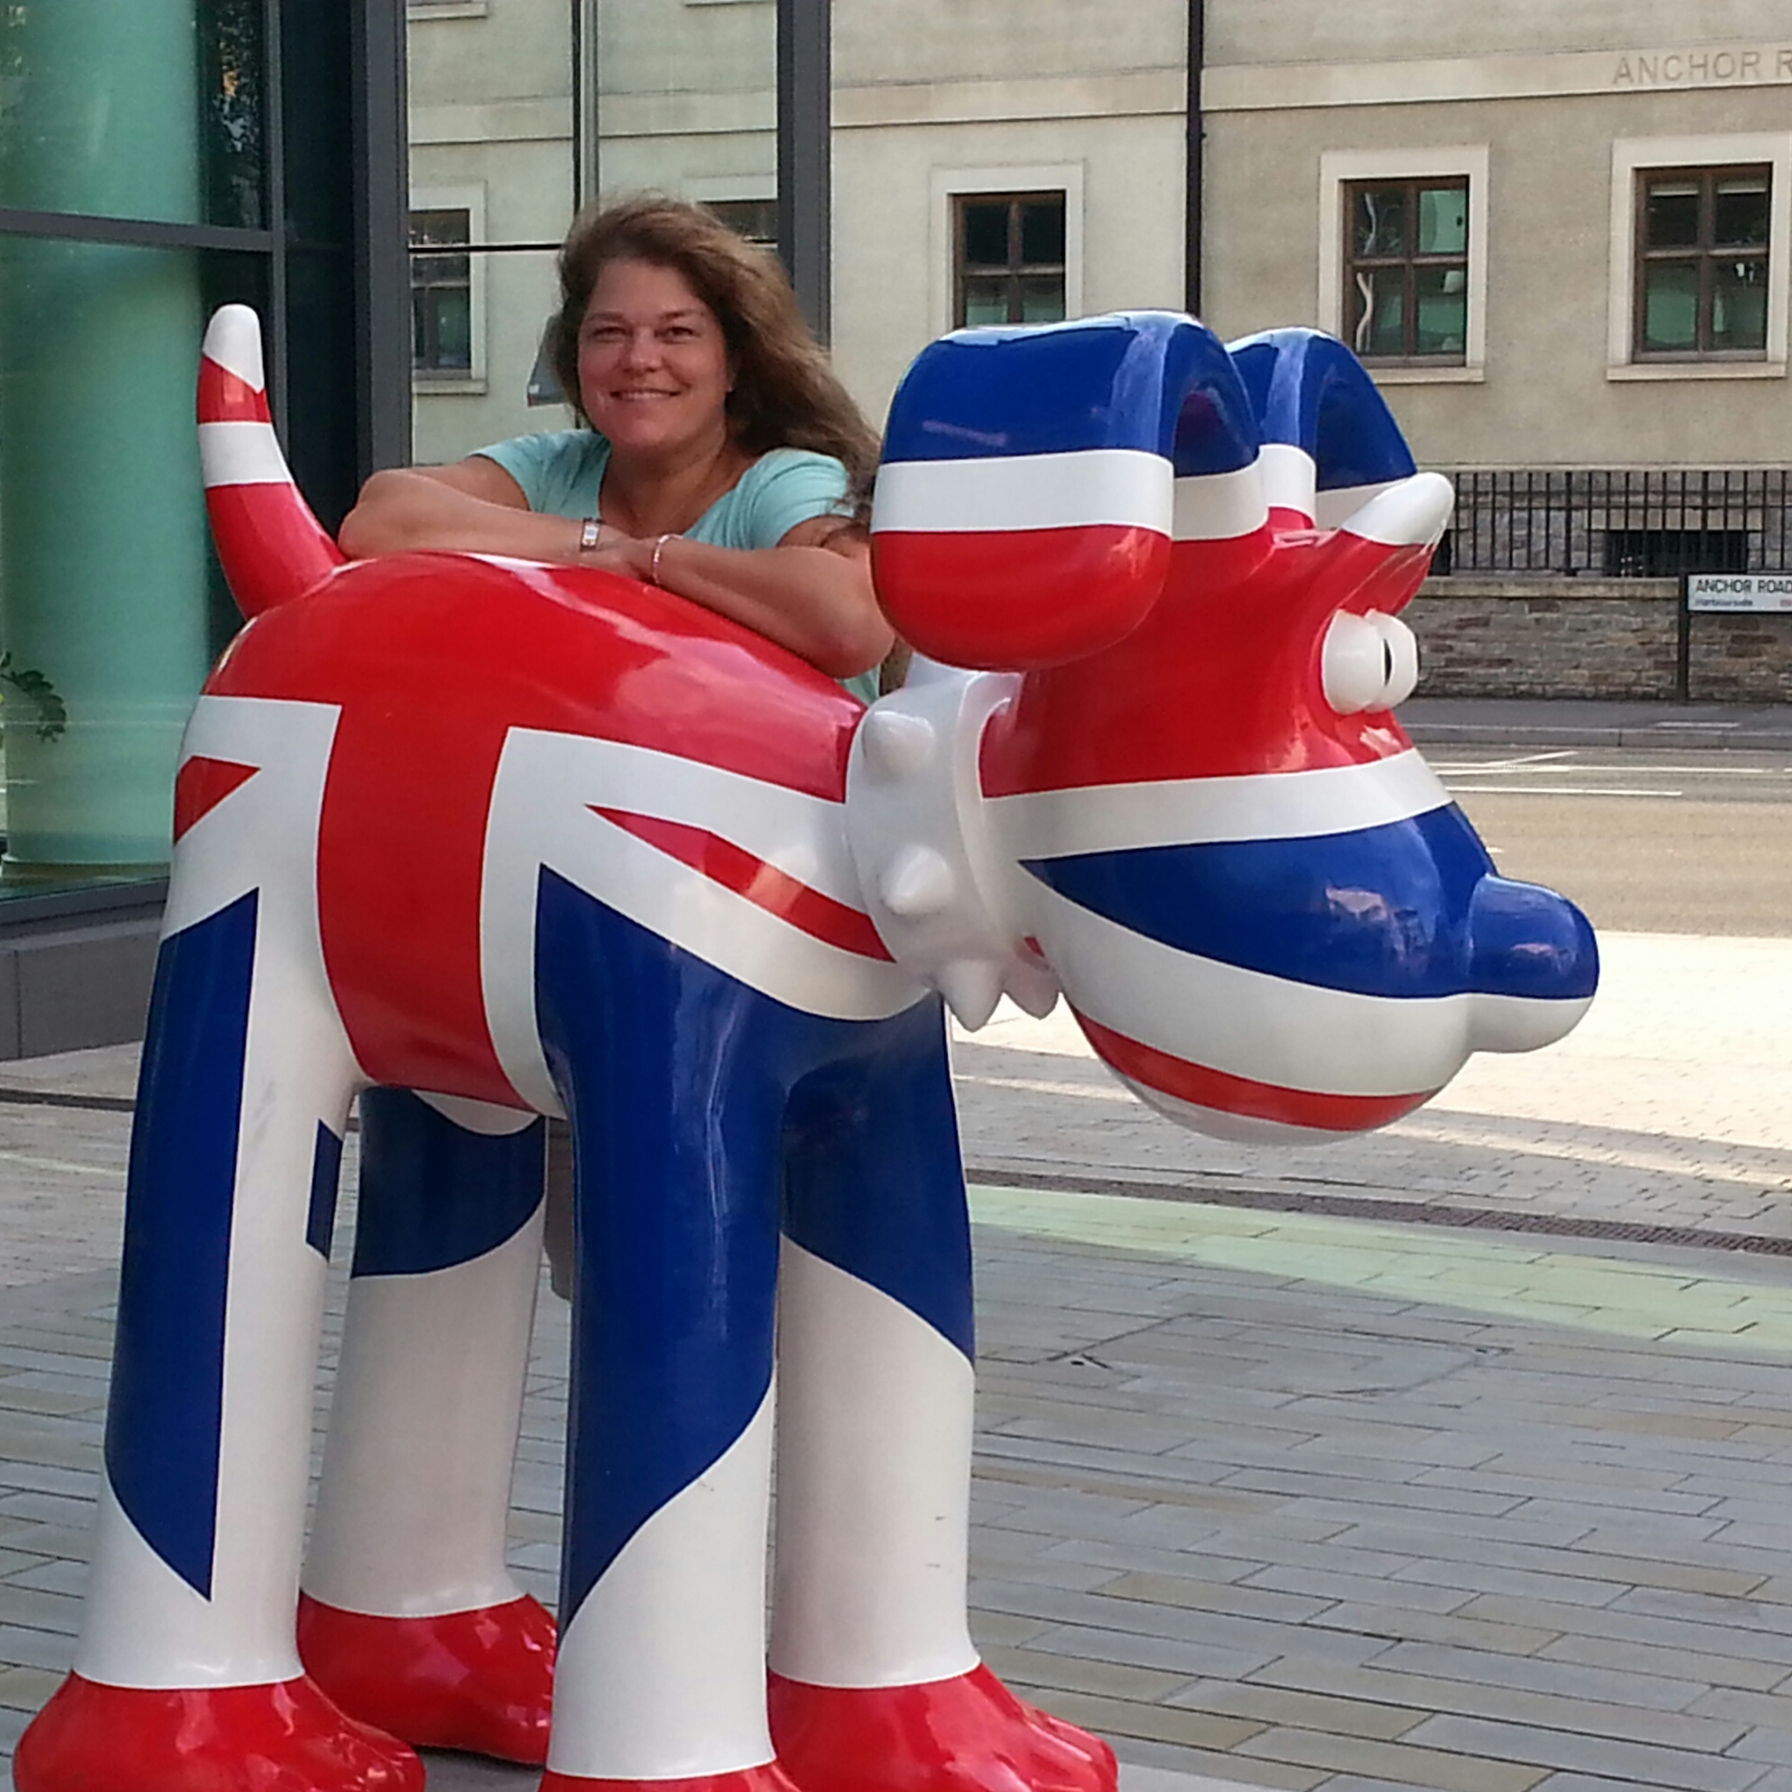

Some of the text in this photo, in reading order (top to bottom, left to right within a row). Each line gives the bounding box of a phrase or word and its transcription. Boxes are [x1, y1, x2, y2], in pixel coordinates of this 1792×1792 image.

[1614, 52, 1761, 85] ANCHOR
[1696, 579, 1792, 593] ANCHOR ROAD
